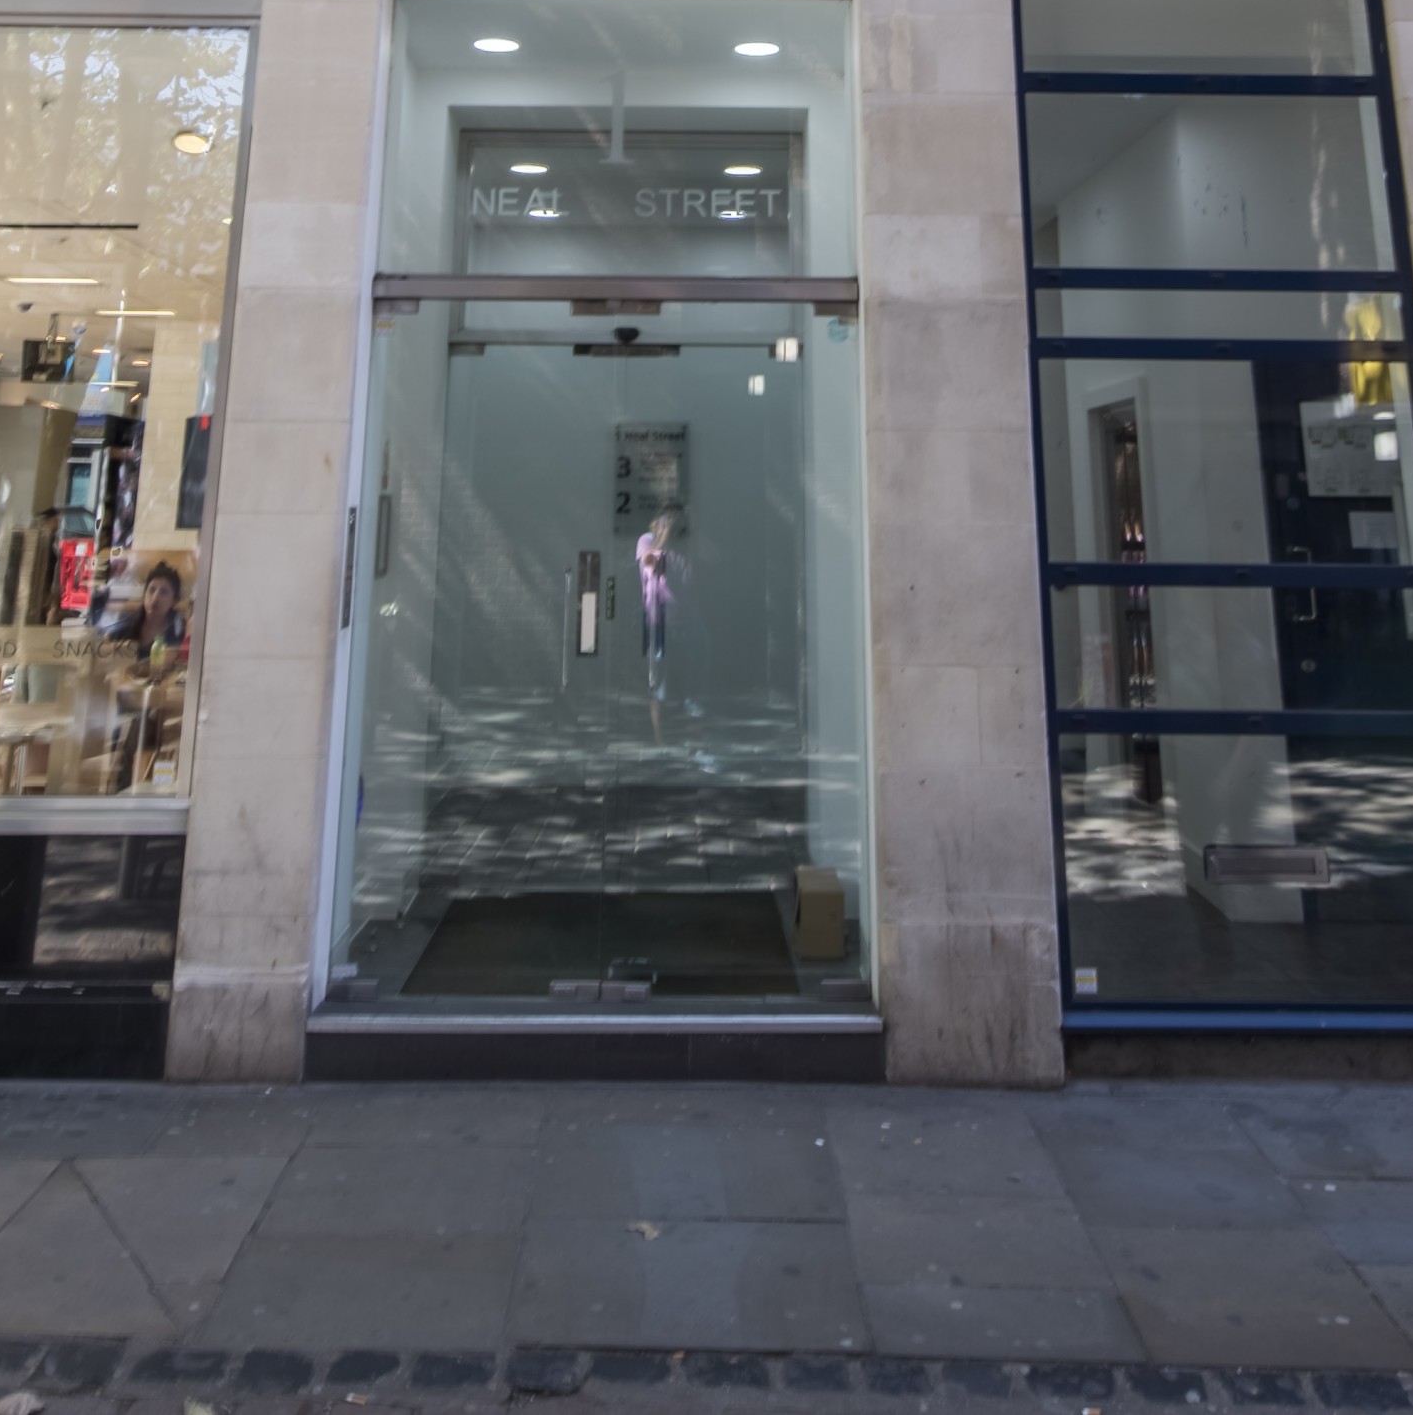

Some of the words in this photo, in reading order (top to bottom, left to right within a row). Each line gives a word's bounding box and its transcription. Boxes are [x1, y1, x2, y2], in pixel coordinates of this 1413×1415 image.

[600, 70, 632, 165] 1
[472, 186, 569, 218] NEAL
[634, 188, 781, 219] STREET
[652, 431, 686, 442] Street
[617, 455, 631, 479] 3
[616, 491, 631, 515] 2
[52, 639, 139, 658] SNACKS
